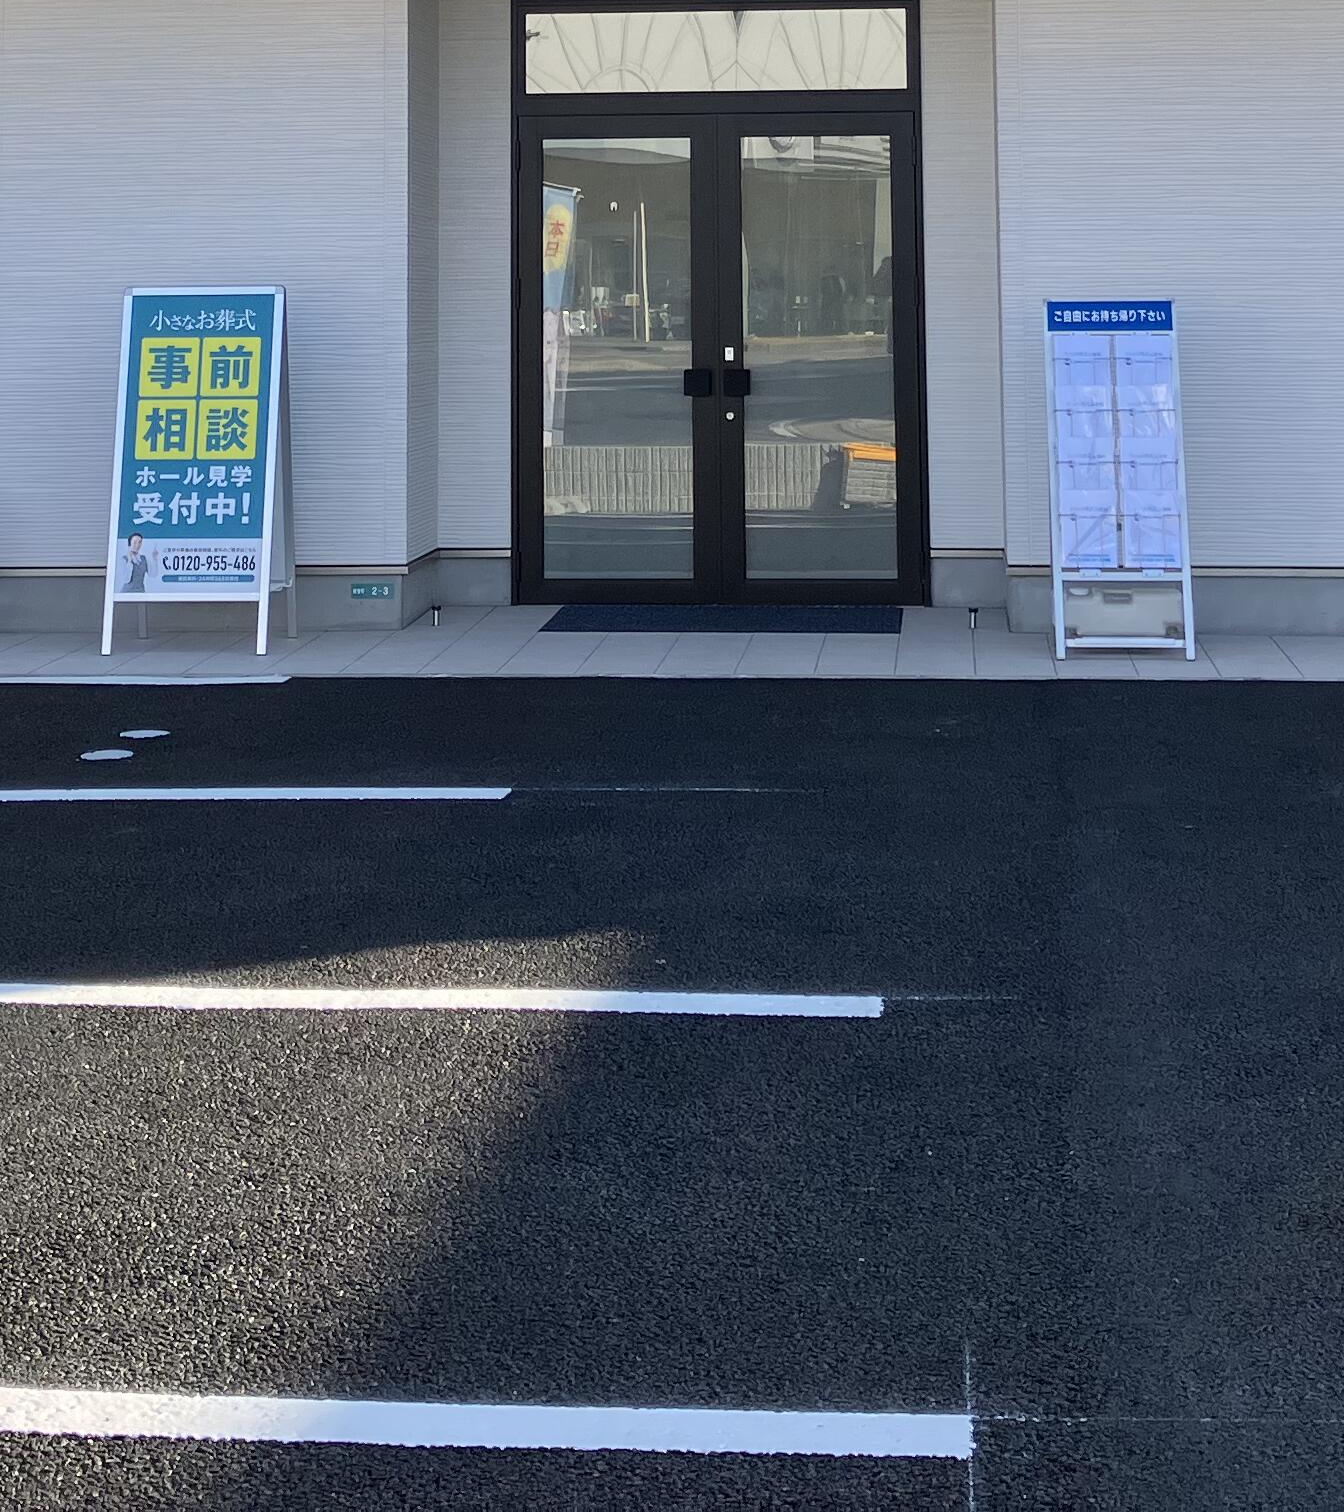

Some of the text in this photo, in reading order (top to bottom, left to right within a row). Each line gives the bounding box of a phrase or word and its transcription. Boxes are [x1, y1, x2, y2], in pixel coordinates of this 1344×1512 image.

[149, 308, 257, 332] 小さなお葬式
[1053, 309, 1166, 323] ご自由にお持ち帰り下さい
[147, 345, 254, 390] 事前
[143, 407, 250, 453] 相談
[135, 465, 253, 488] ホール見学
[172, 555, 257, 572] 0120-955-486
